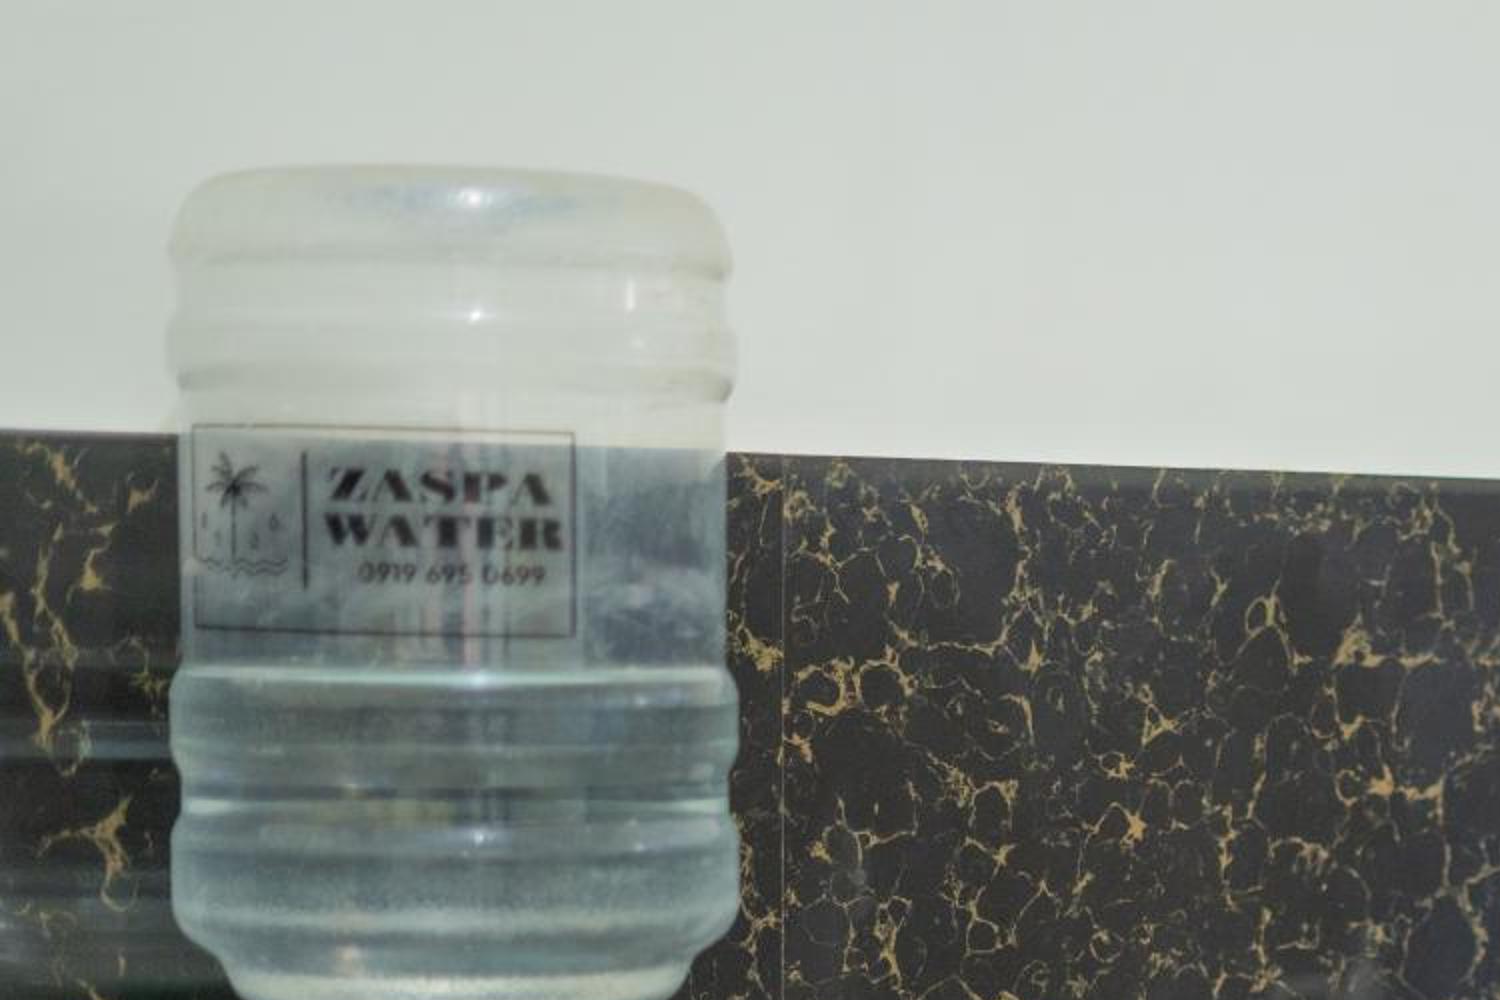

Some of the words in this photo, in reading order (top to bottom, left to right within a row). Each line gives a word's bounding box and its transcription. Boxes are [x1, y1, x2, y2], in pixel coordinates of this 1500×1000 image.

[329, 468, 552, 506] ZASPA
[324, 513, 562, 551] WATER
[358, 561, 417, 584] 0919
